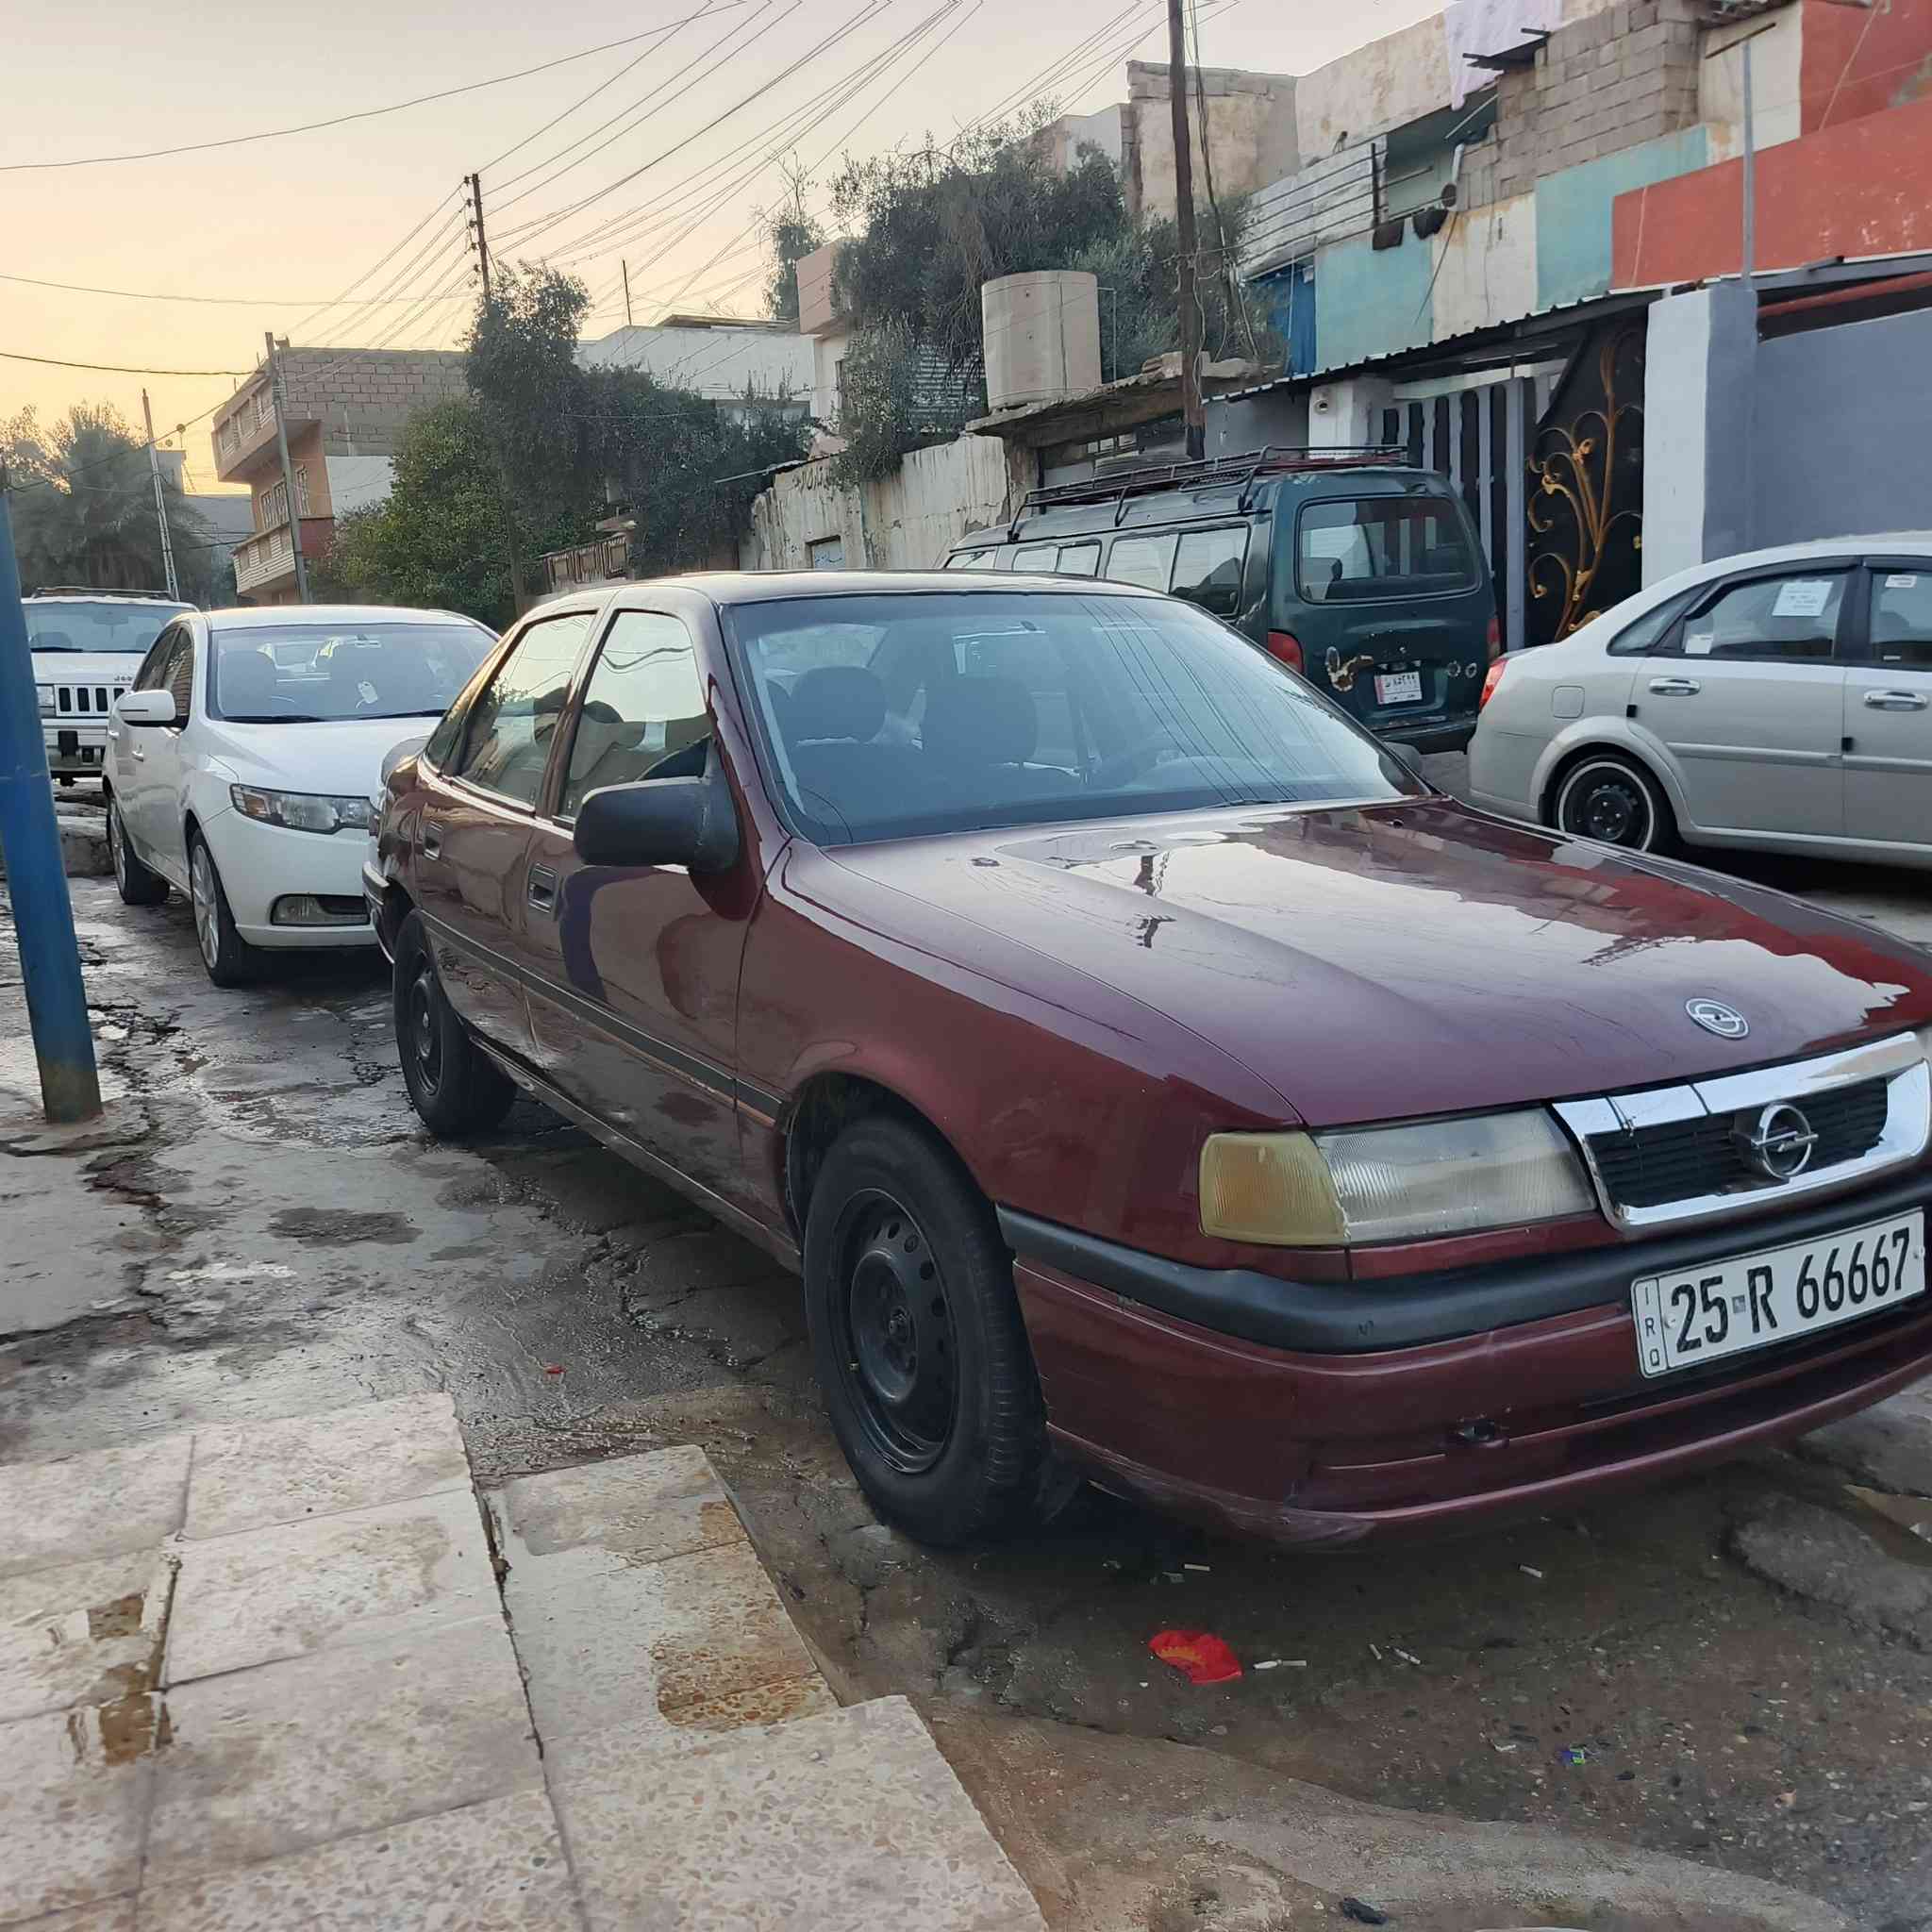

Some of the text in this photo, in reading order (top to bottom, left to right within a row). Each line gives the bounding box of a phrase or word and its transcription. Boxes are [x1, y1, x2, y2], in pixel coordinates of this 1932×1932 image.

[1671, 1226, 1910, 1353] 25 R 66667
